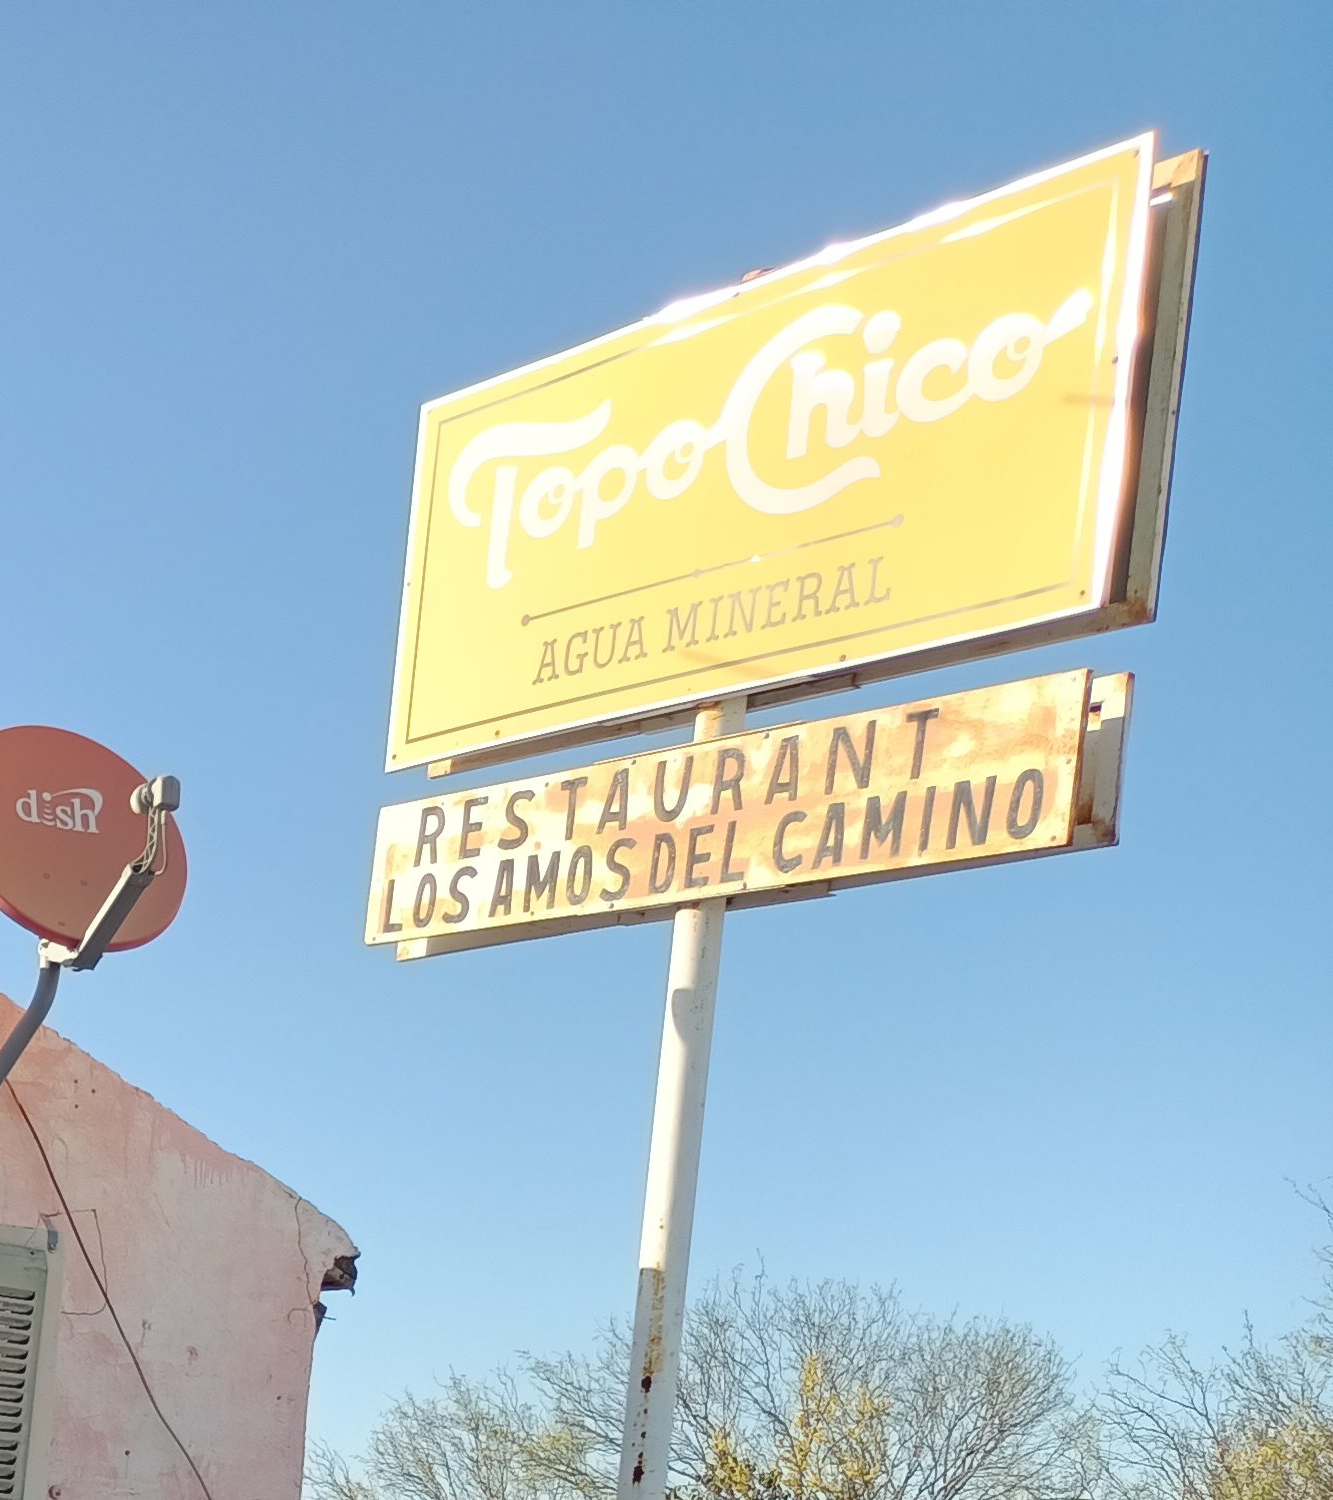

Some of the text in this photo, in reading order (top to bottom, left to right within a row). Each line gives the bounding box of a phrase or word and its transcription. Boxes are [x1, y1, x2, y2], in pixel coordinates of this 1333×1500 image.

[448, 288, 1093, 589] Topo Chico
[532, 556, 892, 685] AGUA MINERAL
[15, 788, 103, 833] dish
[416, 708, 939, 866] RESTAURANT
[649, 823, 744, 894] DEL
[773, 769, 1045, 872] CAMINO
